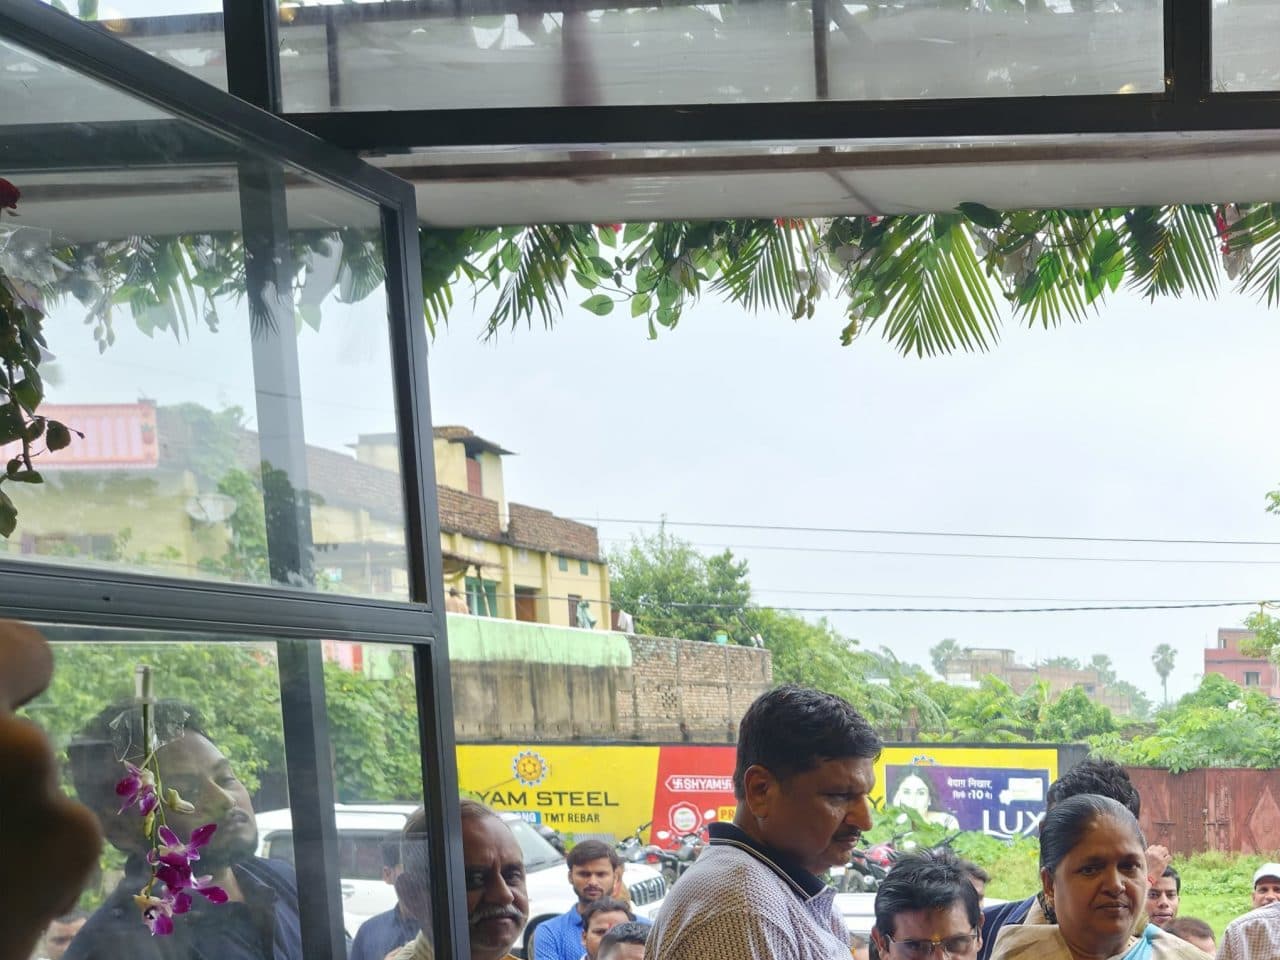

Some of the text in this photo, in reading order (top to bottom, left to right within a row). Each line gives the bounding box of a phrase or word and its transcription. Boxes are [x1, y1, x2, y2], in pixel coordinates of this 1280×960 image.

[684, 778, 720, 791] SHYAM
[536, 791, 620, 807] STEEL
[545, 812, 565, 823] TMT
[568, 812, 600, 824] REBAR
[983, 810, 1046, 836] LUX
